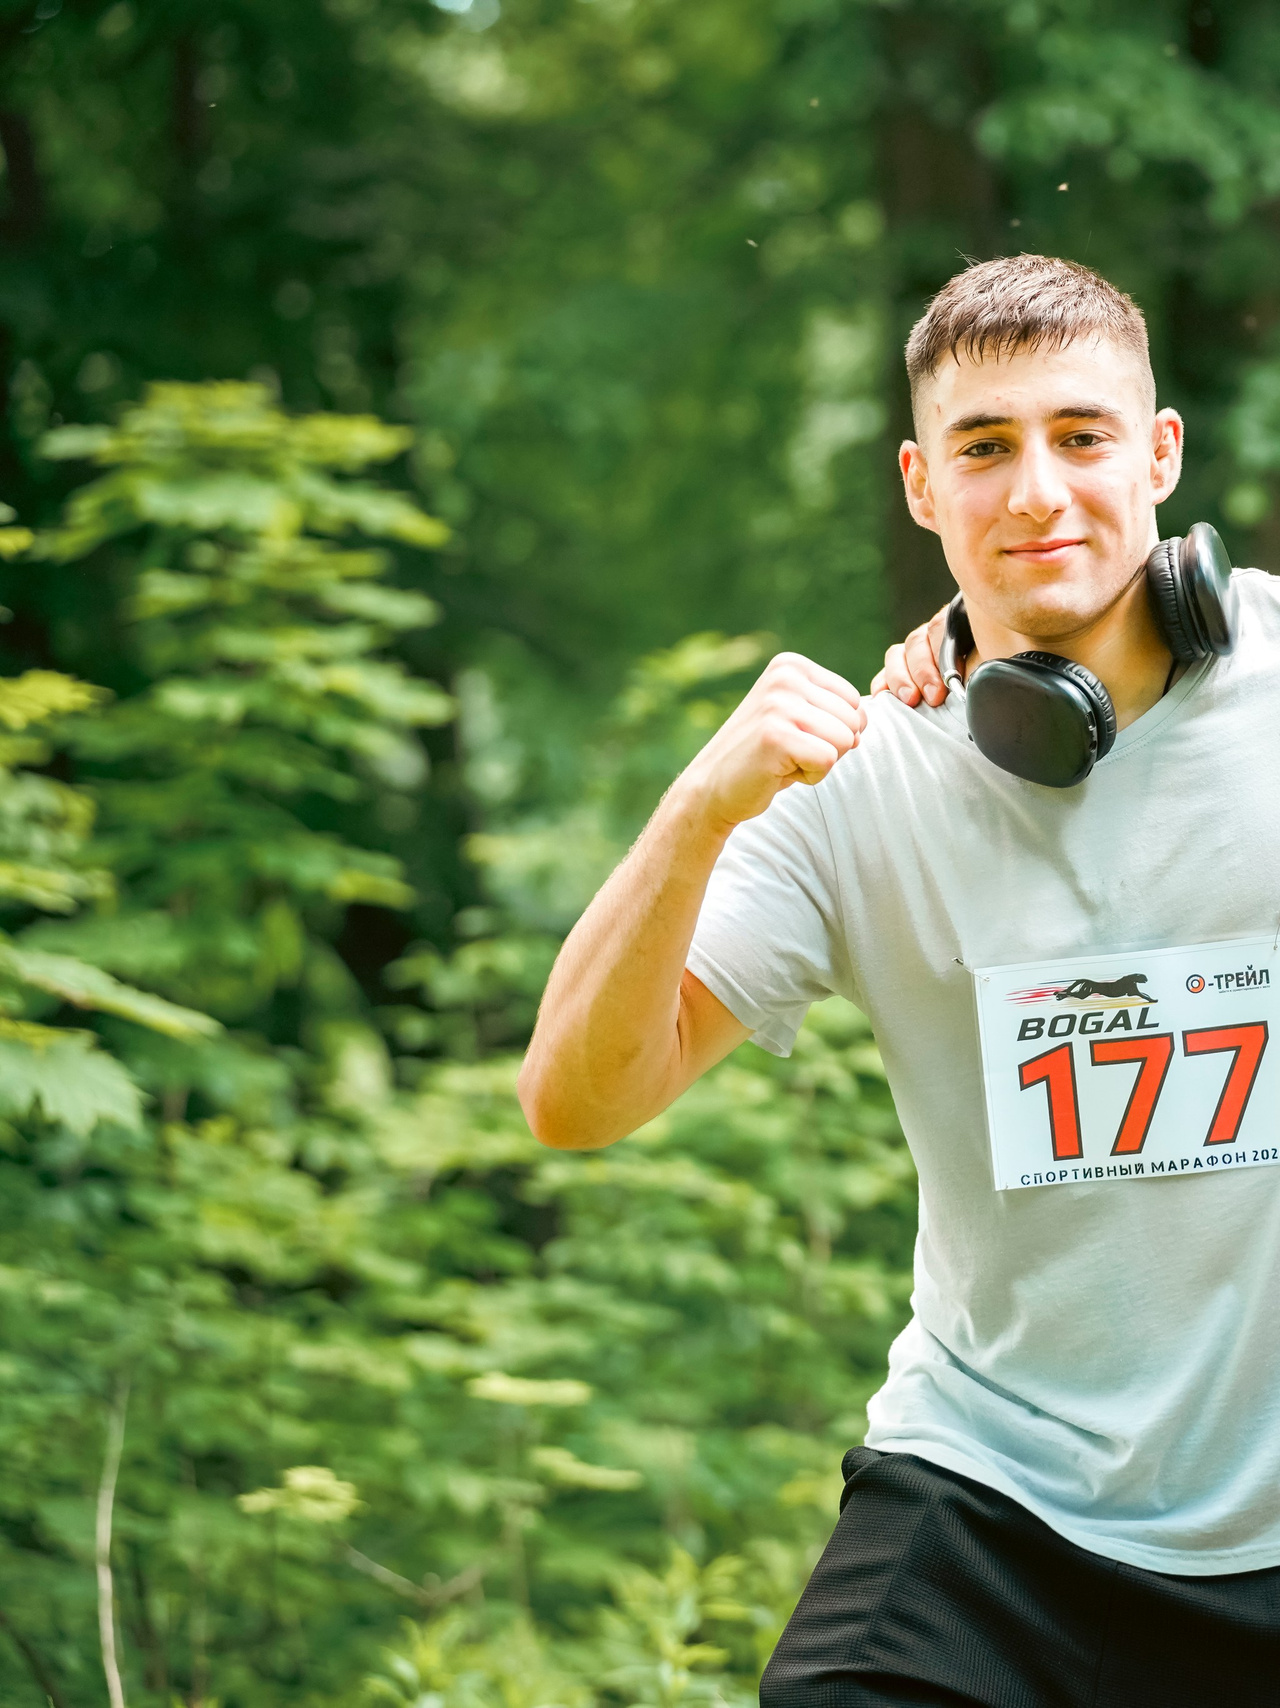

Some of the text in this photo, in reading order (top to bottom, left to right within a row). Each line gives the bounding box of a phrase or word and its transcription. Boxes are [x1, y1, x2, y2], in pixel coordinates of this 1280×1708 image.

[1017, 1007, 1160, 1041] BOGAL
[1018, 1021, 1270, 1161] 177
[1020, 1163, 1145, 1186] СПОРТИВНЫЙ
[1151, 1151, 1246, 1173] МАРАФОН
